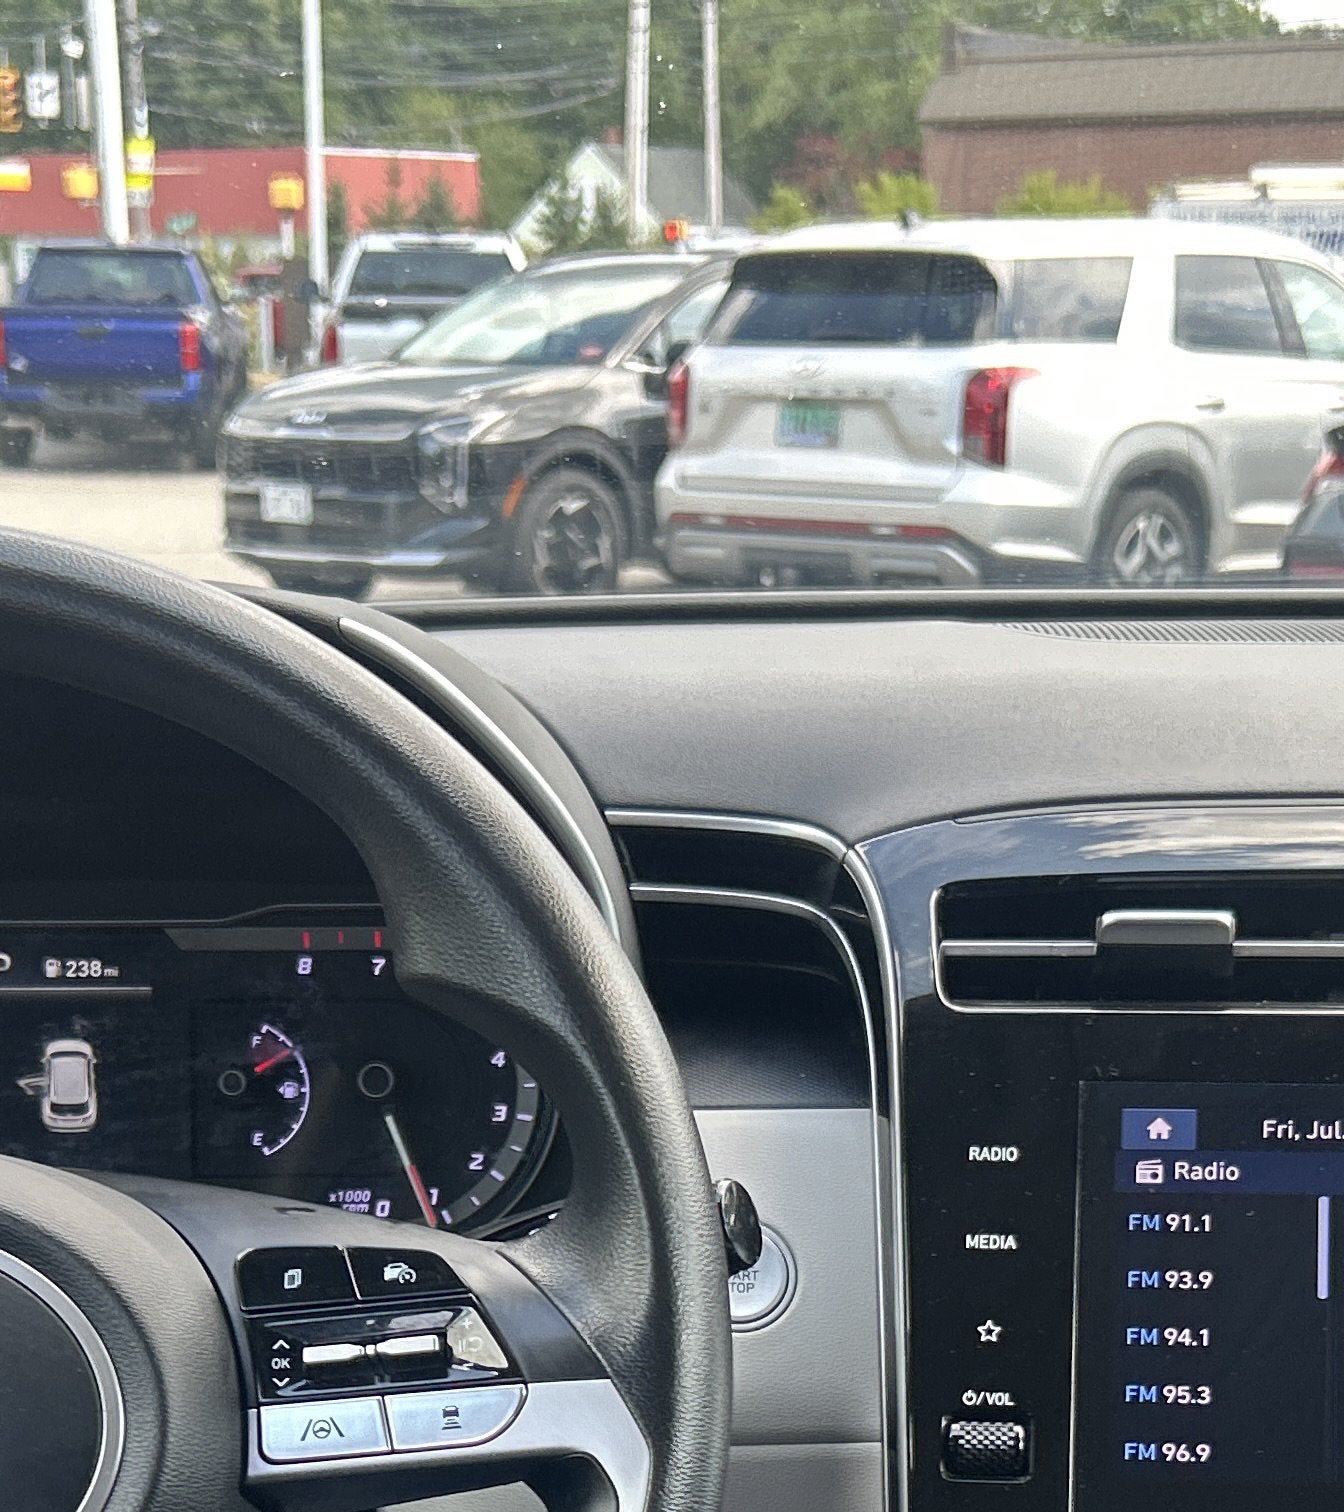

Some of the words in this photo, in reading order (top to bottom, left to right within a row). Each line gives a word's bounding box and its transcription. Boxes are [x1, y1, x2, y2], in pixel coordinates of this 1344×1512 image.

[65, 960, 103, 978] 238
[104, 966, 119, 977] mi
[297, 958, 312, 975] 8
[371, 959, 386, 975] 7
[252, 1035, 263, 1047] F
[490, 1051, 505, 1067] 4
[491, 1105, 507, 1122] 3
[1262, 1118, 1301, 1141] Fri,
[253, 1134, 263, 1146] E
[469, 1154, 484, 1170] 2
[968, 1145, 1018, 1162] RADIO
[1174, 1161, 1240, 1182] Radio
[329, 1190, 372, 1202] x1000
[429, 1188, 439, 1206] 1
[376, 1200, 391, 1217] 0
[1128, 1214, 1160, 1231] FM
[1165, 1214, 1212, 1232] 91.1
[966, 1234, 1017, 1250] MEDIA
[1127, 1271, 1159, 1288] FM
[1164, 1271, 1213, 1289] 93.9
[1126, 1328, 1158, 1345] FM
[1163, 1328, 1210, 1346] 94.1
[271, 1358, 291, 1369] OK
[1125, 1385, 1156, 1402] FM
[1162, 1386, 1211, 1404] 95.3
[1124, 1443, 1156, 1460] FM
[1162, 1444, 1210, 1462] 96.9
